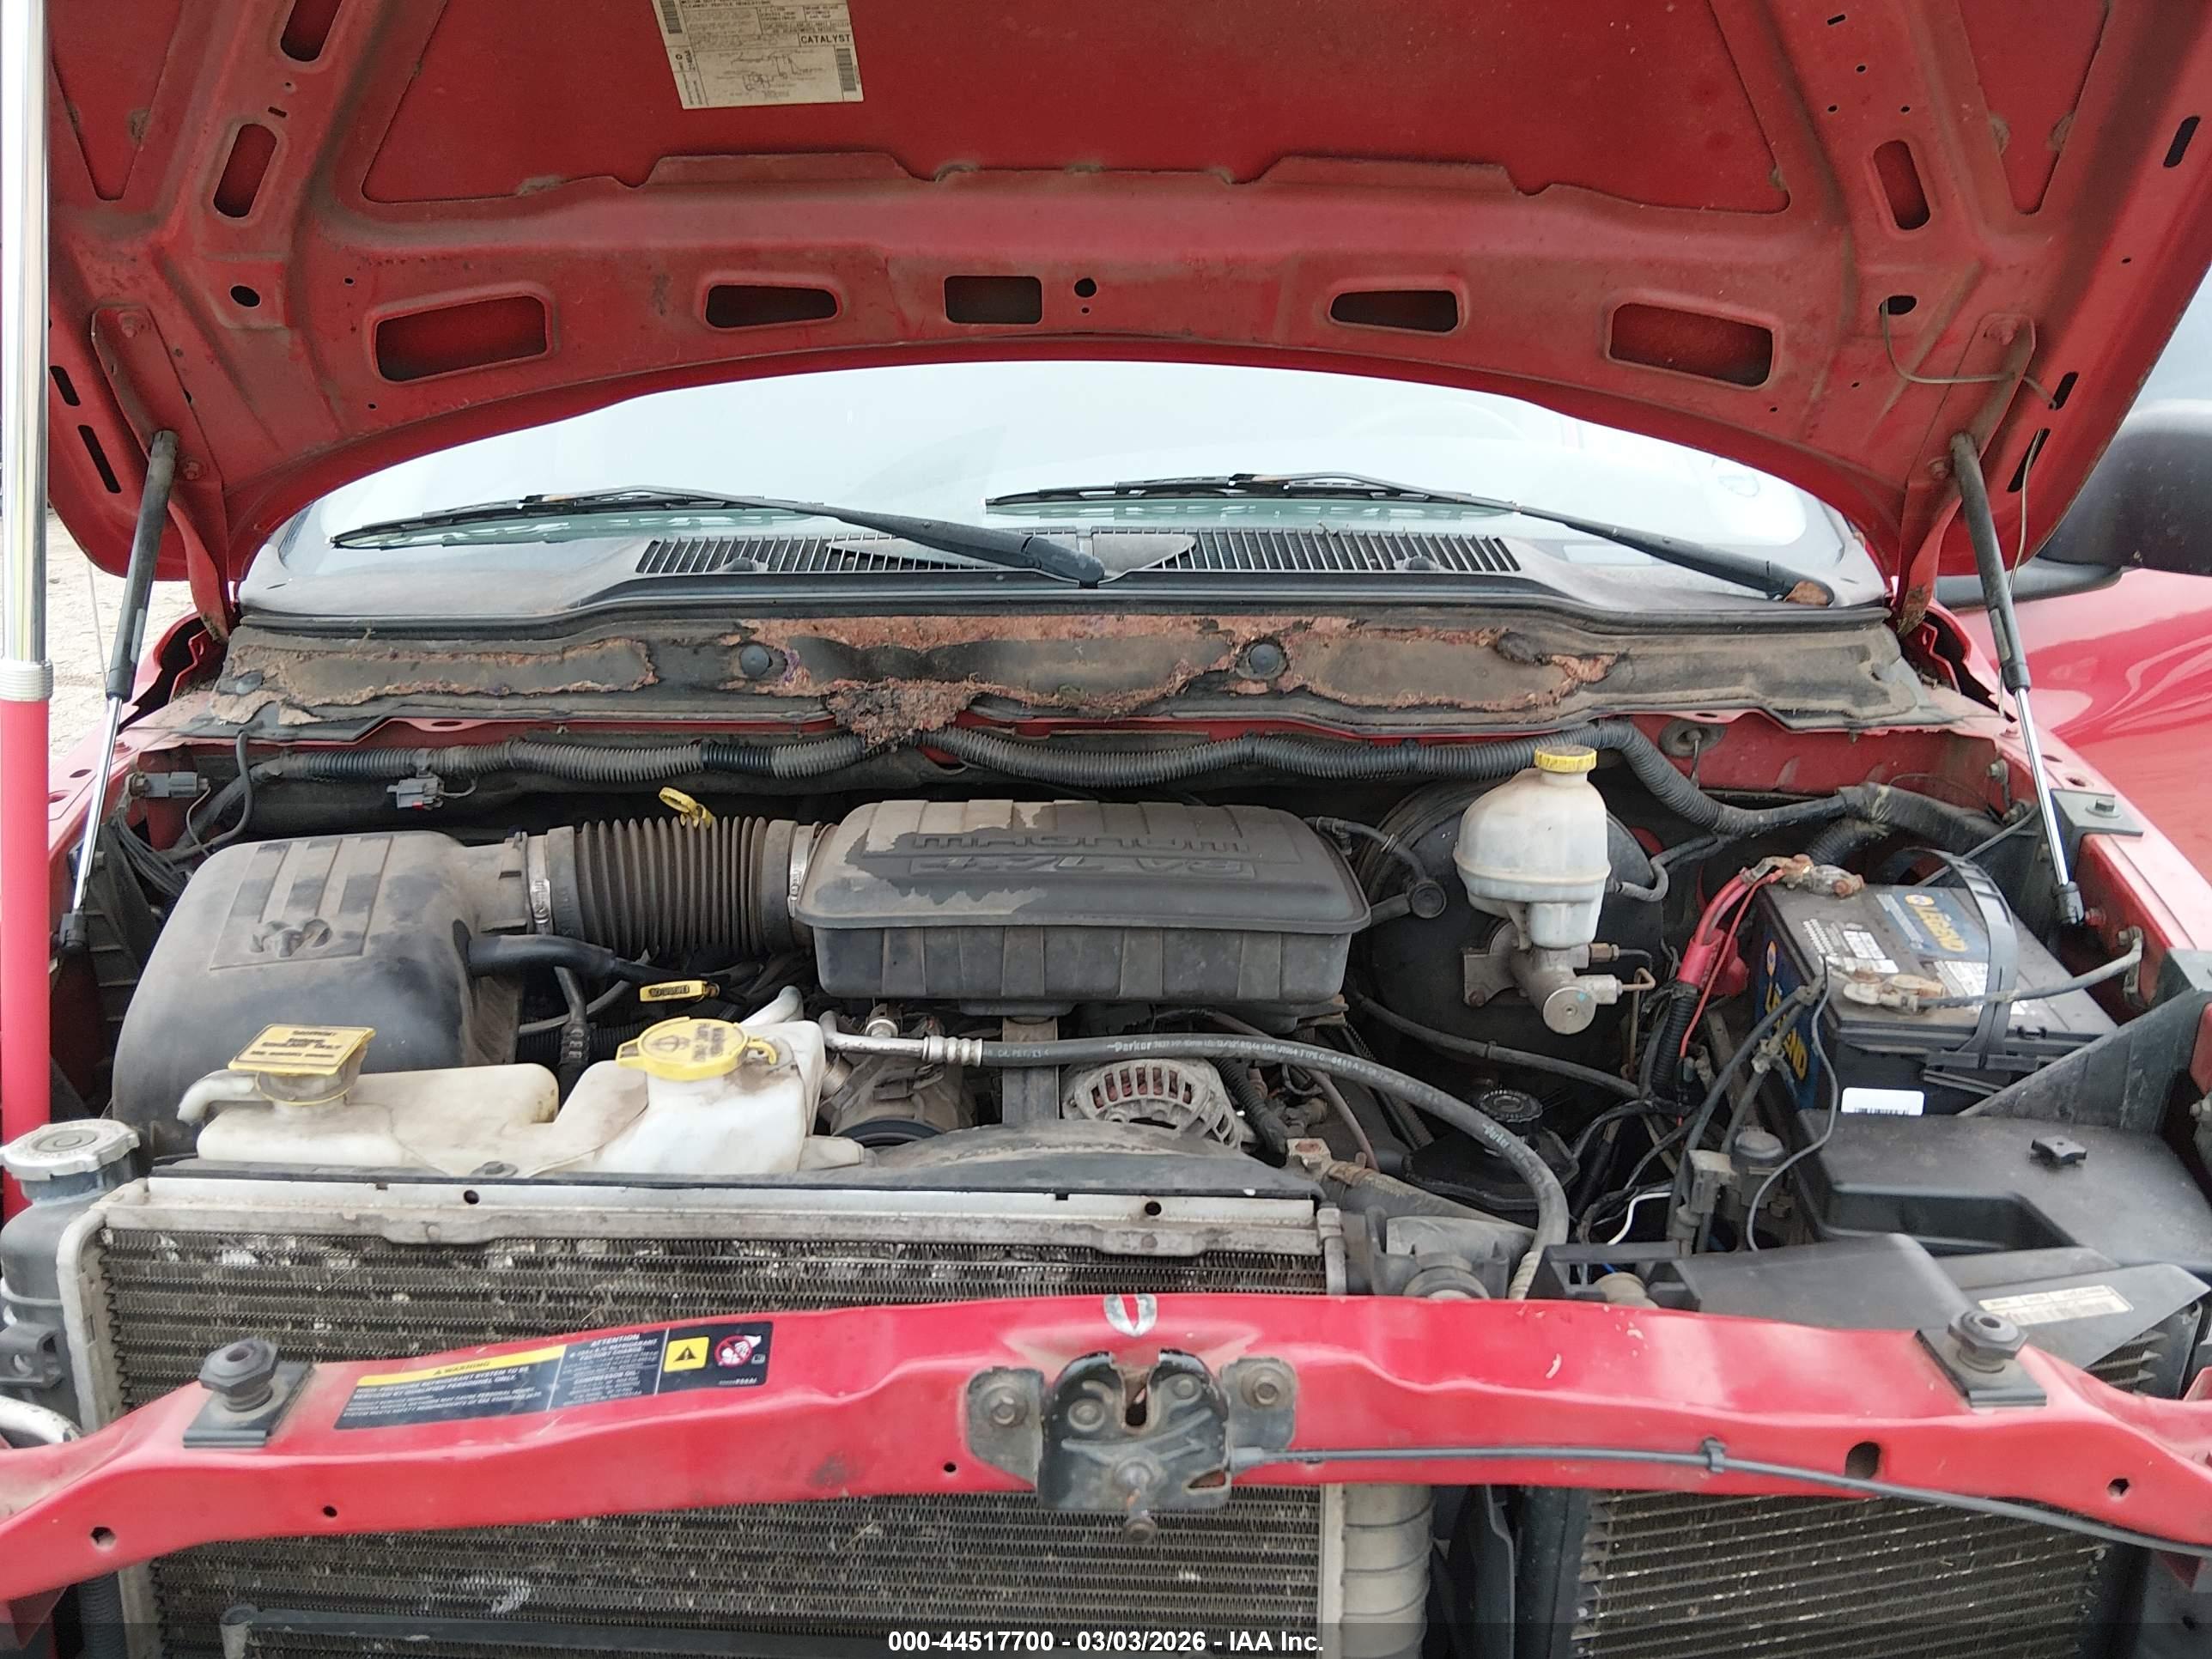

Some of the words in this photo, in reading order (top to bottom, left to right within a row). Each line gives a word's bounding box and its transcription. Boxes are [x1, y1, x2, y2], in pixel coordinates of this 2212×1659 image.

[800, 33, 851, 45] CATALYST
[1114, 1040, 1152, 1053] Parker
[591, 1334, 641, 1348] ATTENTION
[444, 1361, 491, 1374] WARNING
